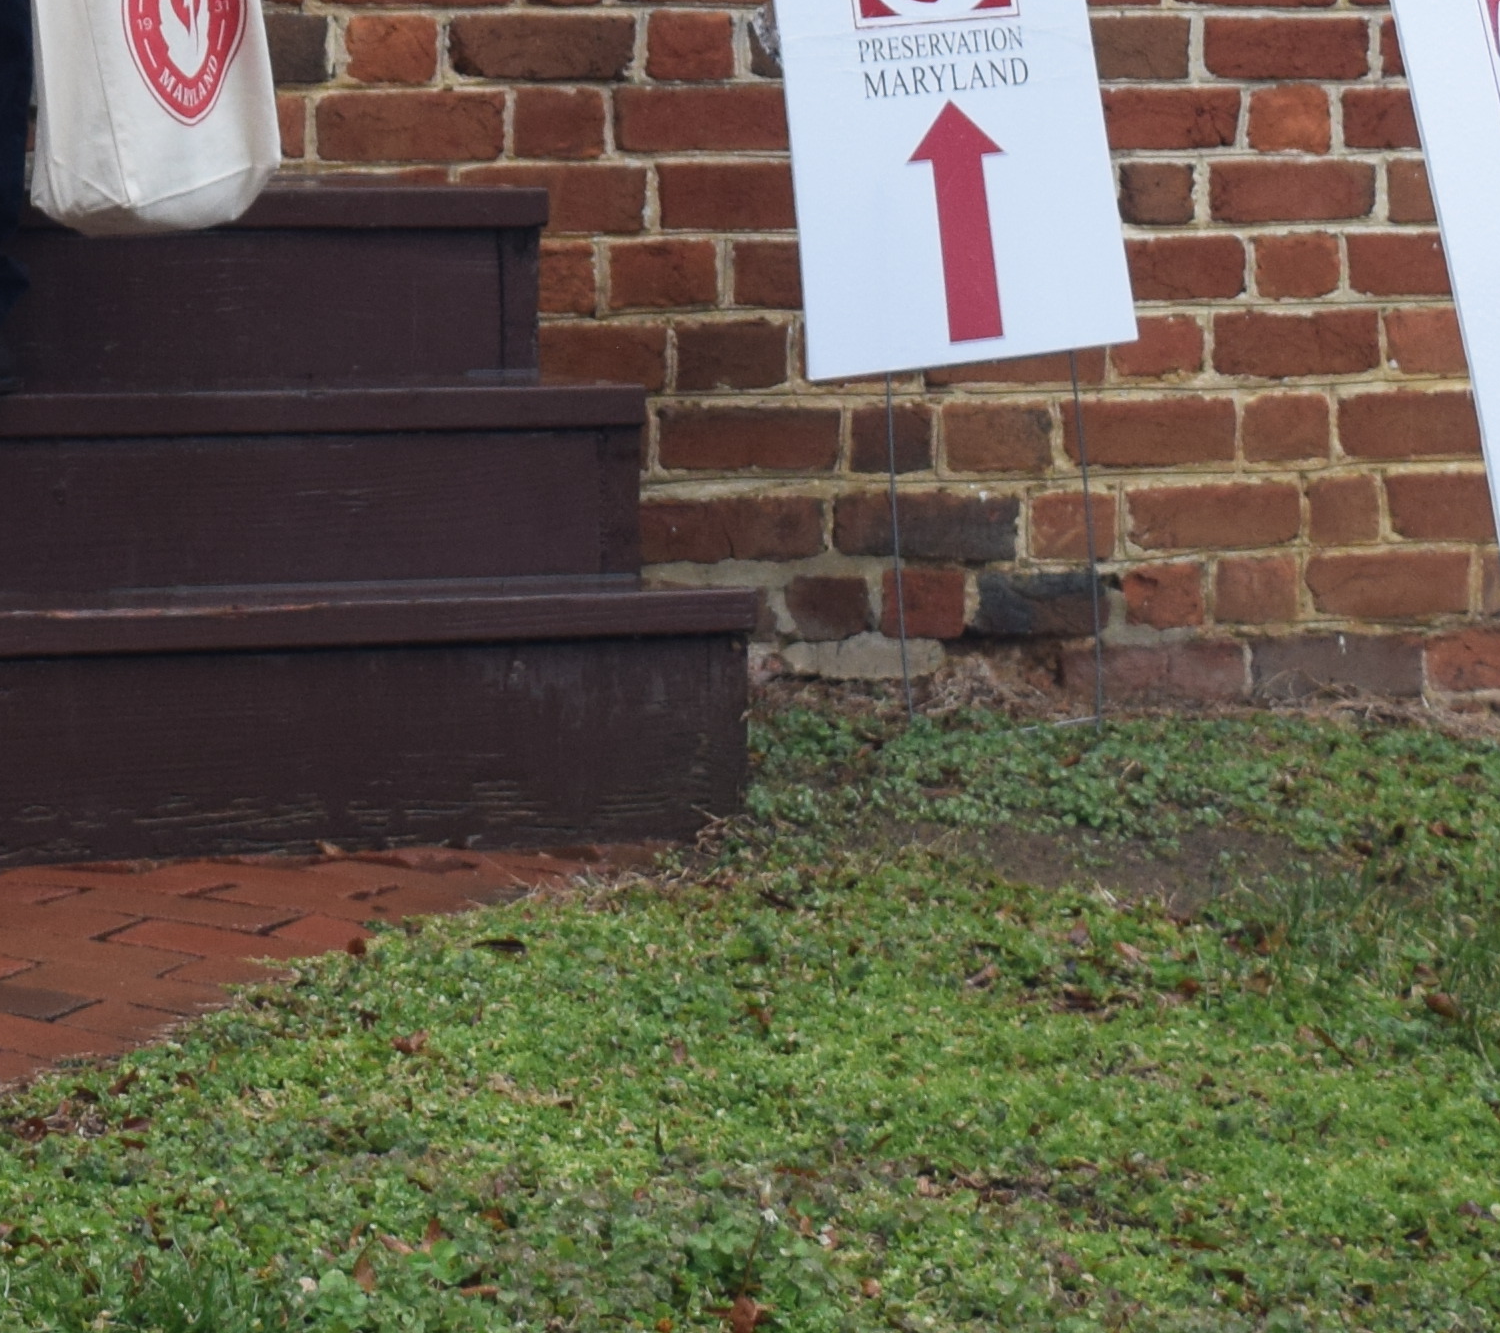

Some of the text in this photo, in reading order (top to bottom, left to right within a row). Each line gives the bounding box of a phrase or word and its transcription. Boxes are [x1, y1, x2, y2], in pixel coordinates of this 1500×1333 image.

[214, 0, 230, 13] 31
[138, 17, 154, 30] 19
[858, 26, 1023, 63] PRESERVATION
[864, 58, 1029, 100] MARYLAND
